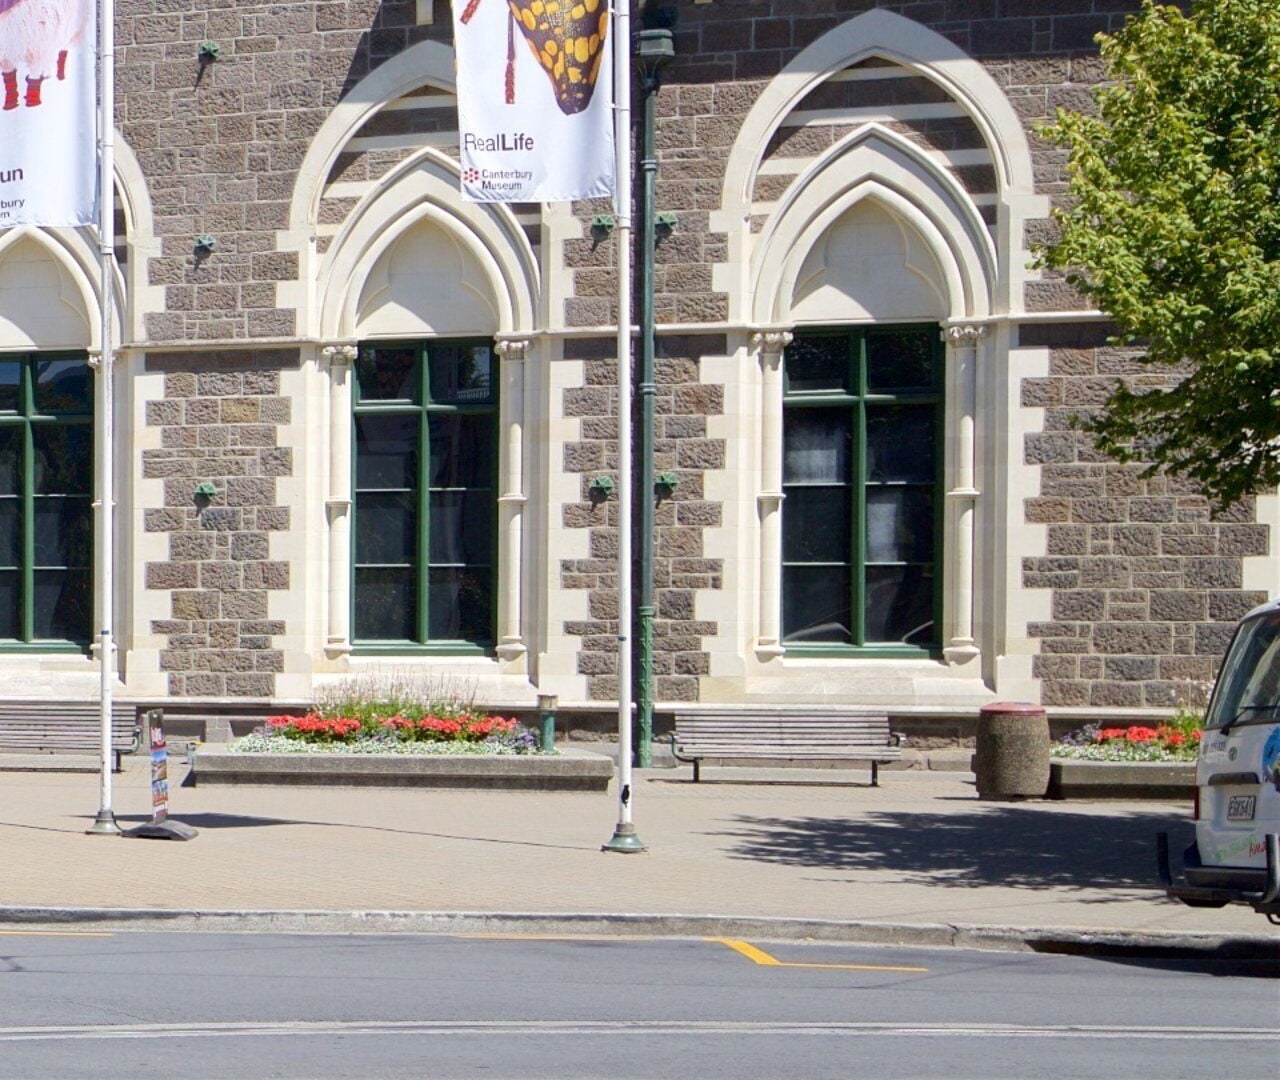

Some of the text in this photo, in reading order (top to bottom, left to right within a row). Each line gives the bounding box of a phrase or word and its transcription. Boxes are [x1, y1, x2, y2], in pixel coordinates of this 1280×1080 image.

[464, 133, 534, 151] RealLife
[482, 169, 532, 180] Canterbury
[482, 181, 522, 190] Museum
